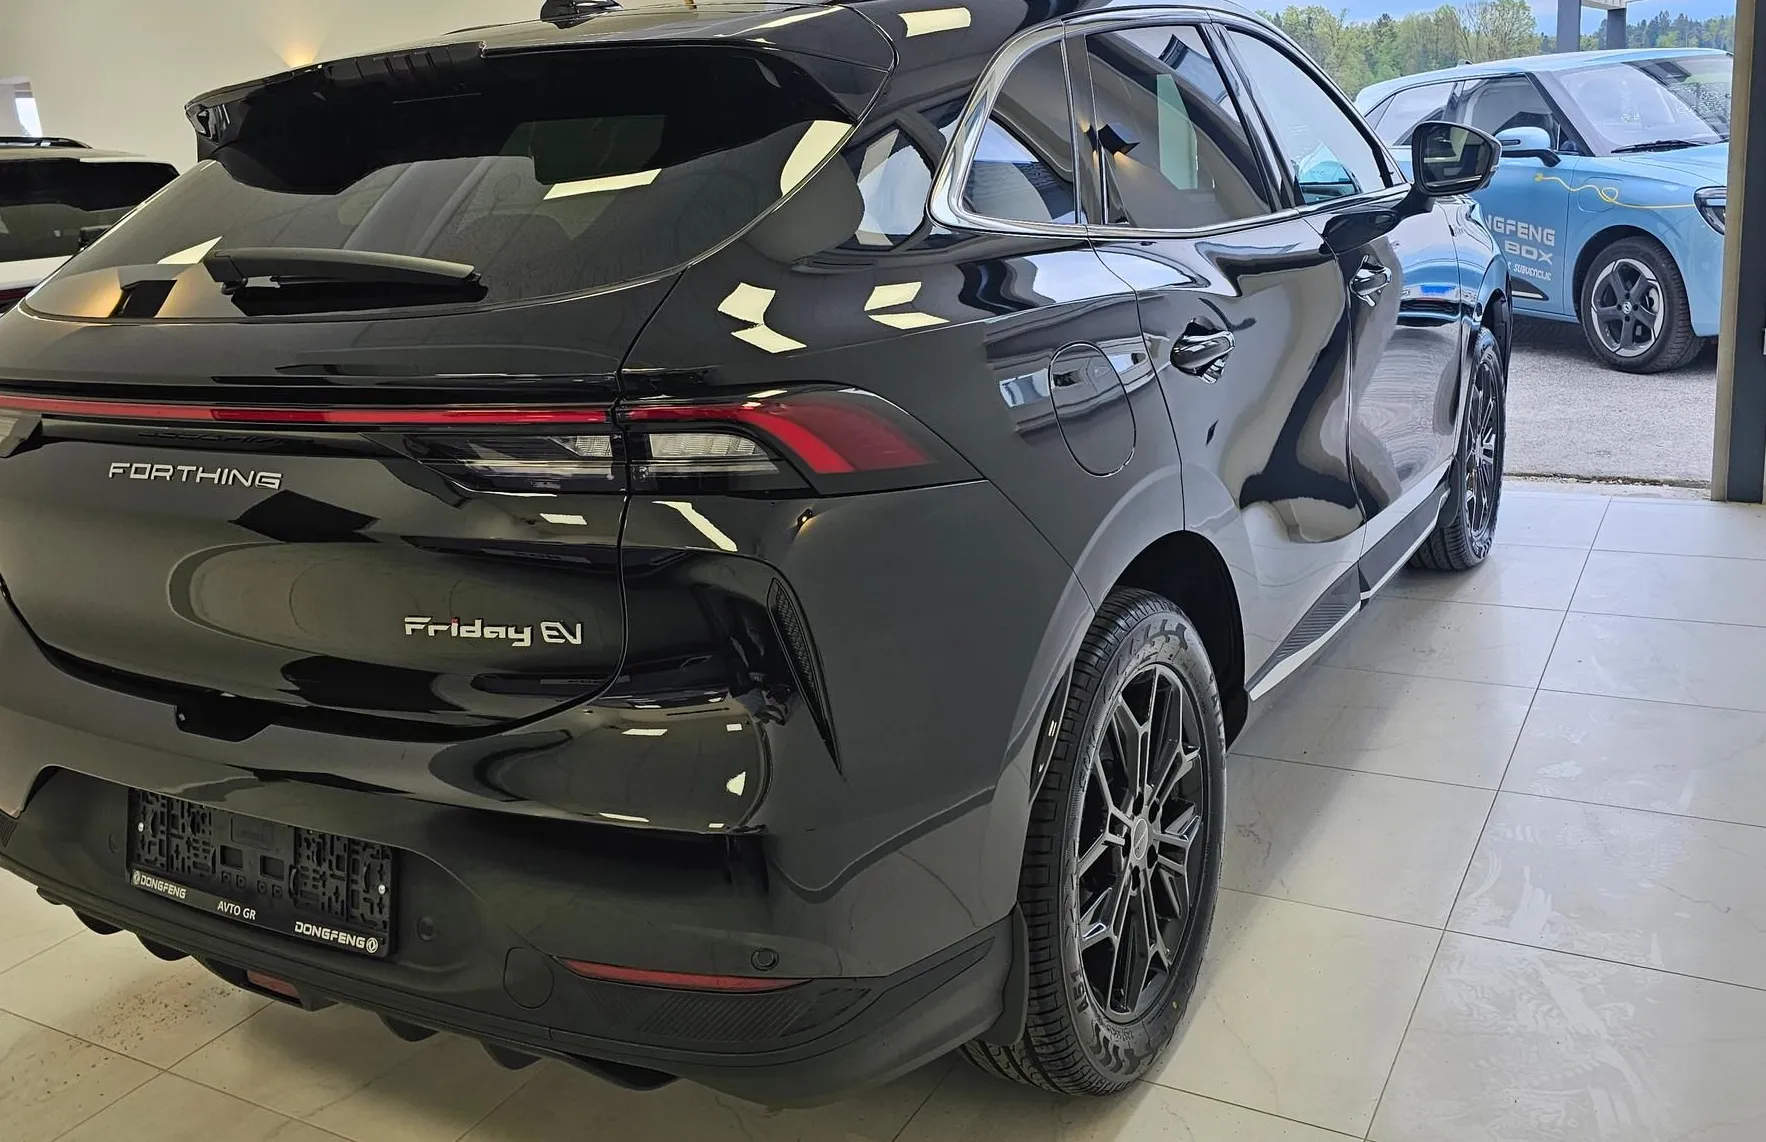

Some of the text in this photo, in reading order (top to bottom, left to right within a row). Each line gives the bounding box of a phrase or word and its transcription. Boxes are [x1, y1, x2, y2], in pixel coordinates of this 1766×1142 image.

[1485, 214, 1555, 247] NGFENG
[1504, 240, 1553, 266] BOX
[108, 462, 282, 490] FORTHING
[404, 616, 582, 647] Friday EV
[139, 873, 187, 900] DONGFENG
[217, 900, 257, 921] AVTO GR
[294, 921, 366, 950] DONGFENG
